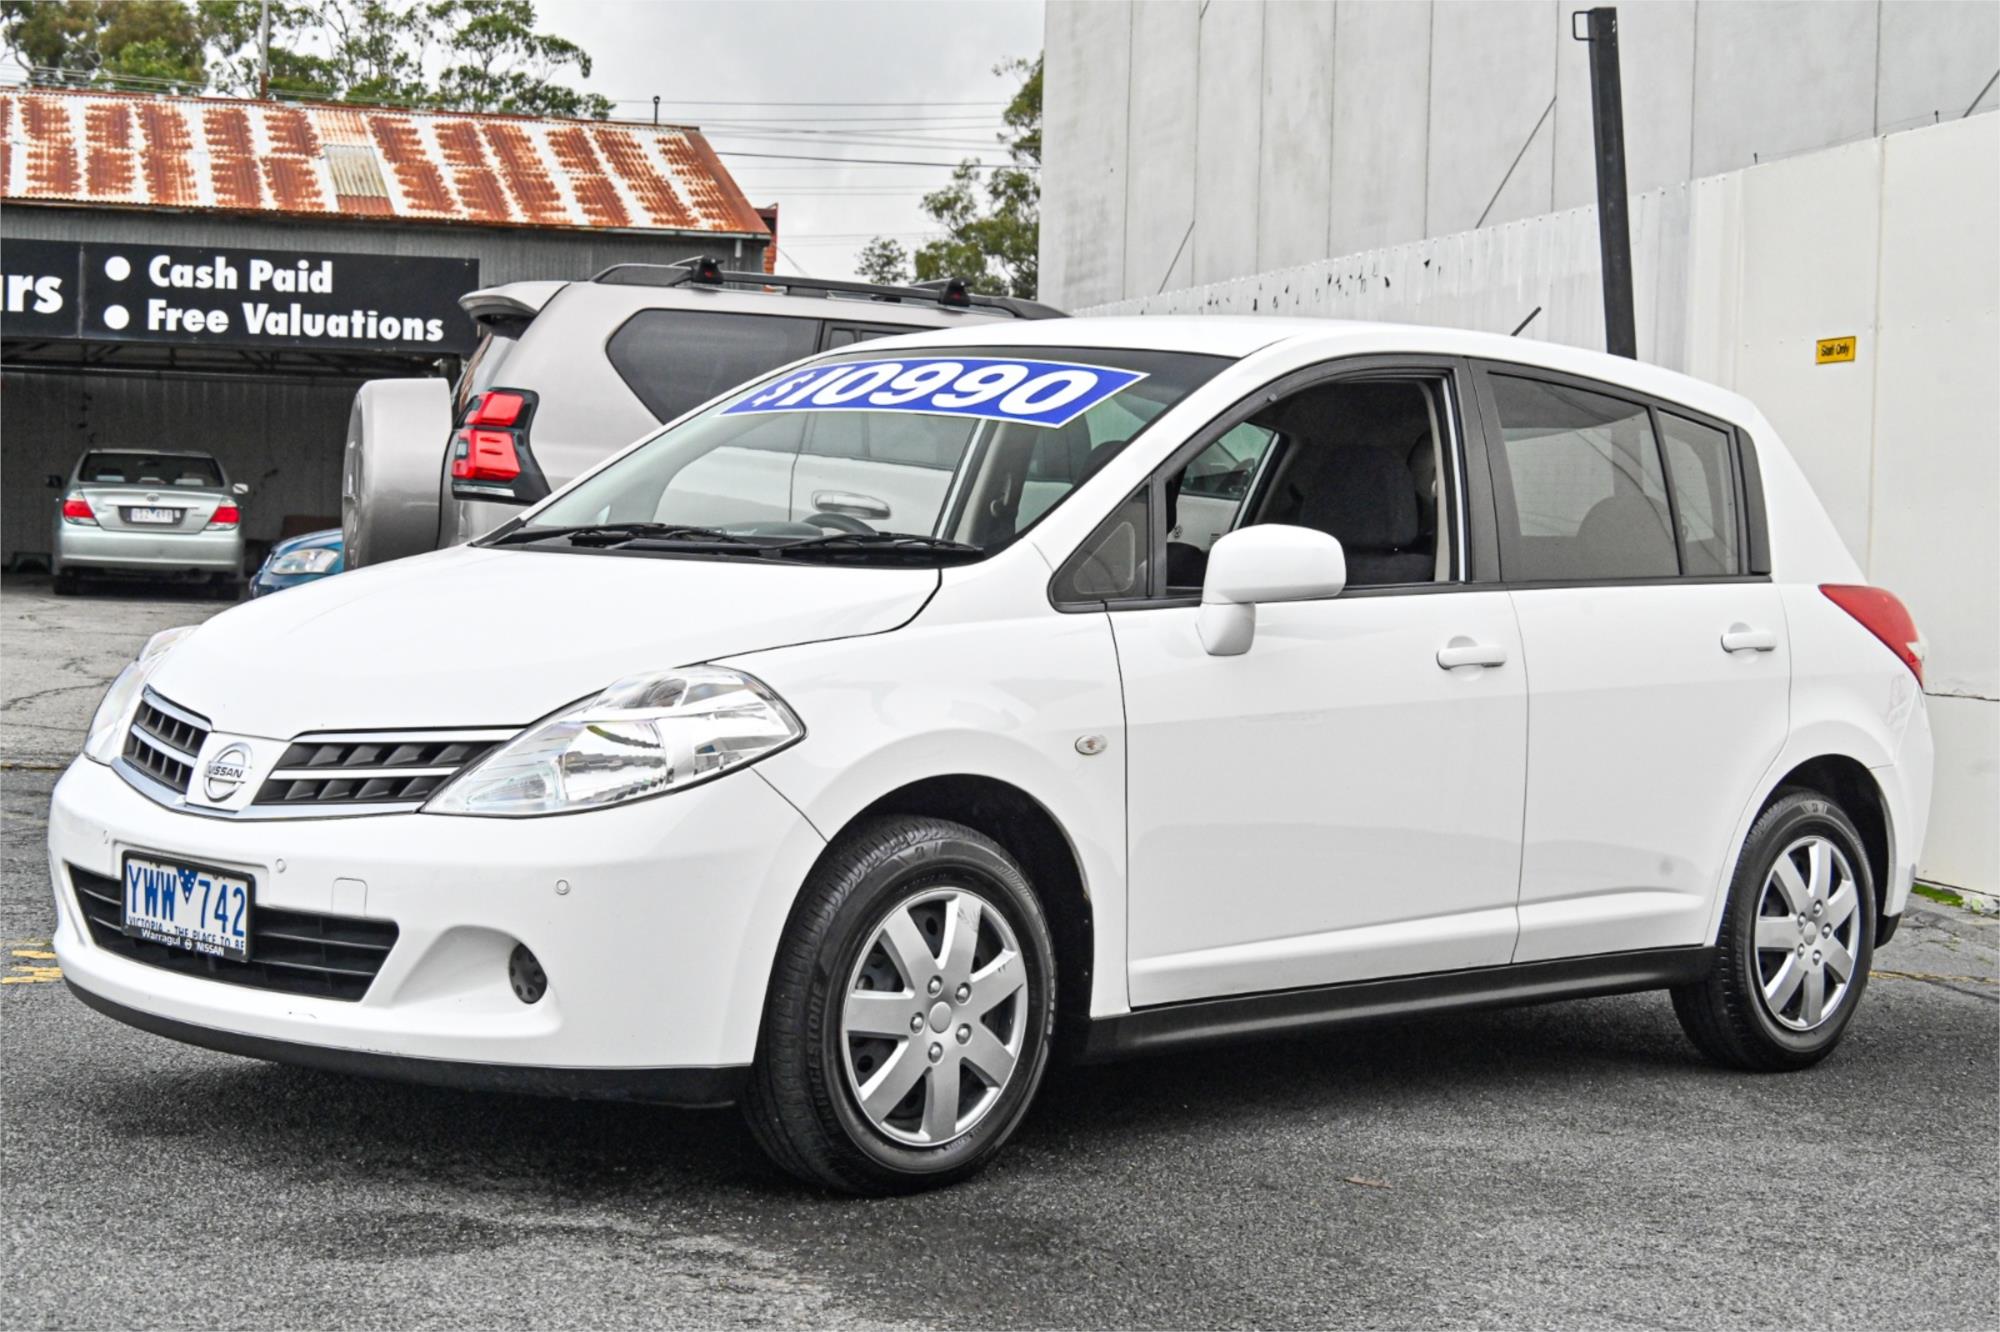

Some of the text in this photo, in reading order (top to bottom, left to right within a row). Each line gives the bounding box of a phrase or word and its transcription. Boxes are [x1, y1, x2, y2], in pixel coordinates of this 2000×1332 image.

[148, 254, 333, 293] Cash Paid
[0, 275, 63, 314] rs
[147, 298, 444, 342] Free Valuations
[751, 361, 1099, 415] $10990
[128, 864, 246, 937] YWW 742
[128, 915, 163, 932] VICTORIA
[174, 925, 189, 938] THE
[192, 930, 217, 943] PLACE
[220, 936, 231, 947] TO
[234, 939, 245, 950] BE
[141, 928, 225, 957] Warragul NISSAN
